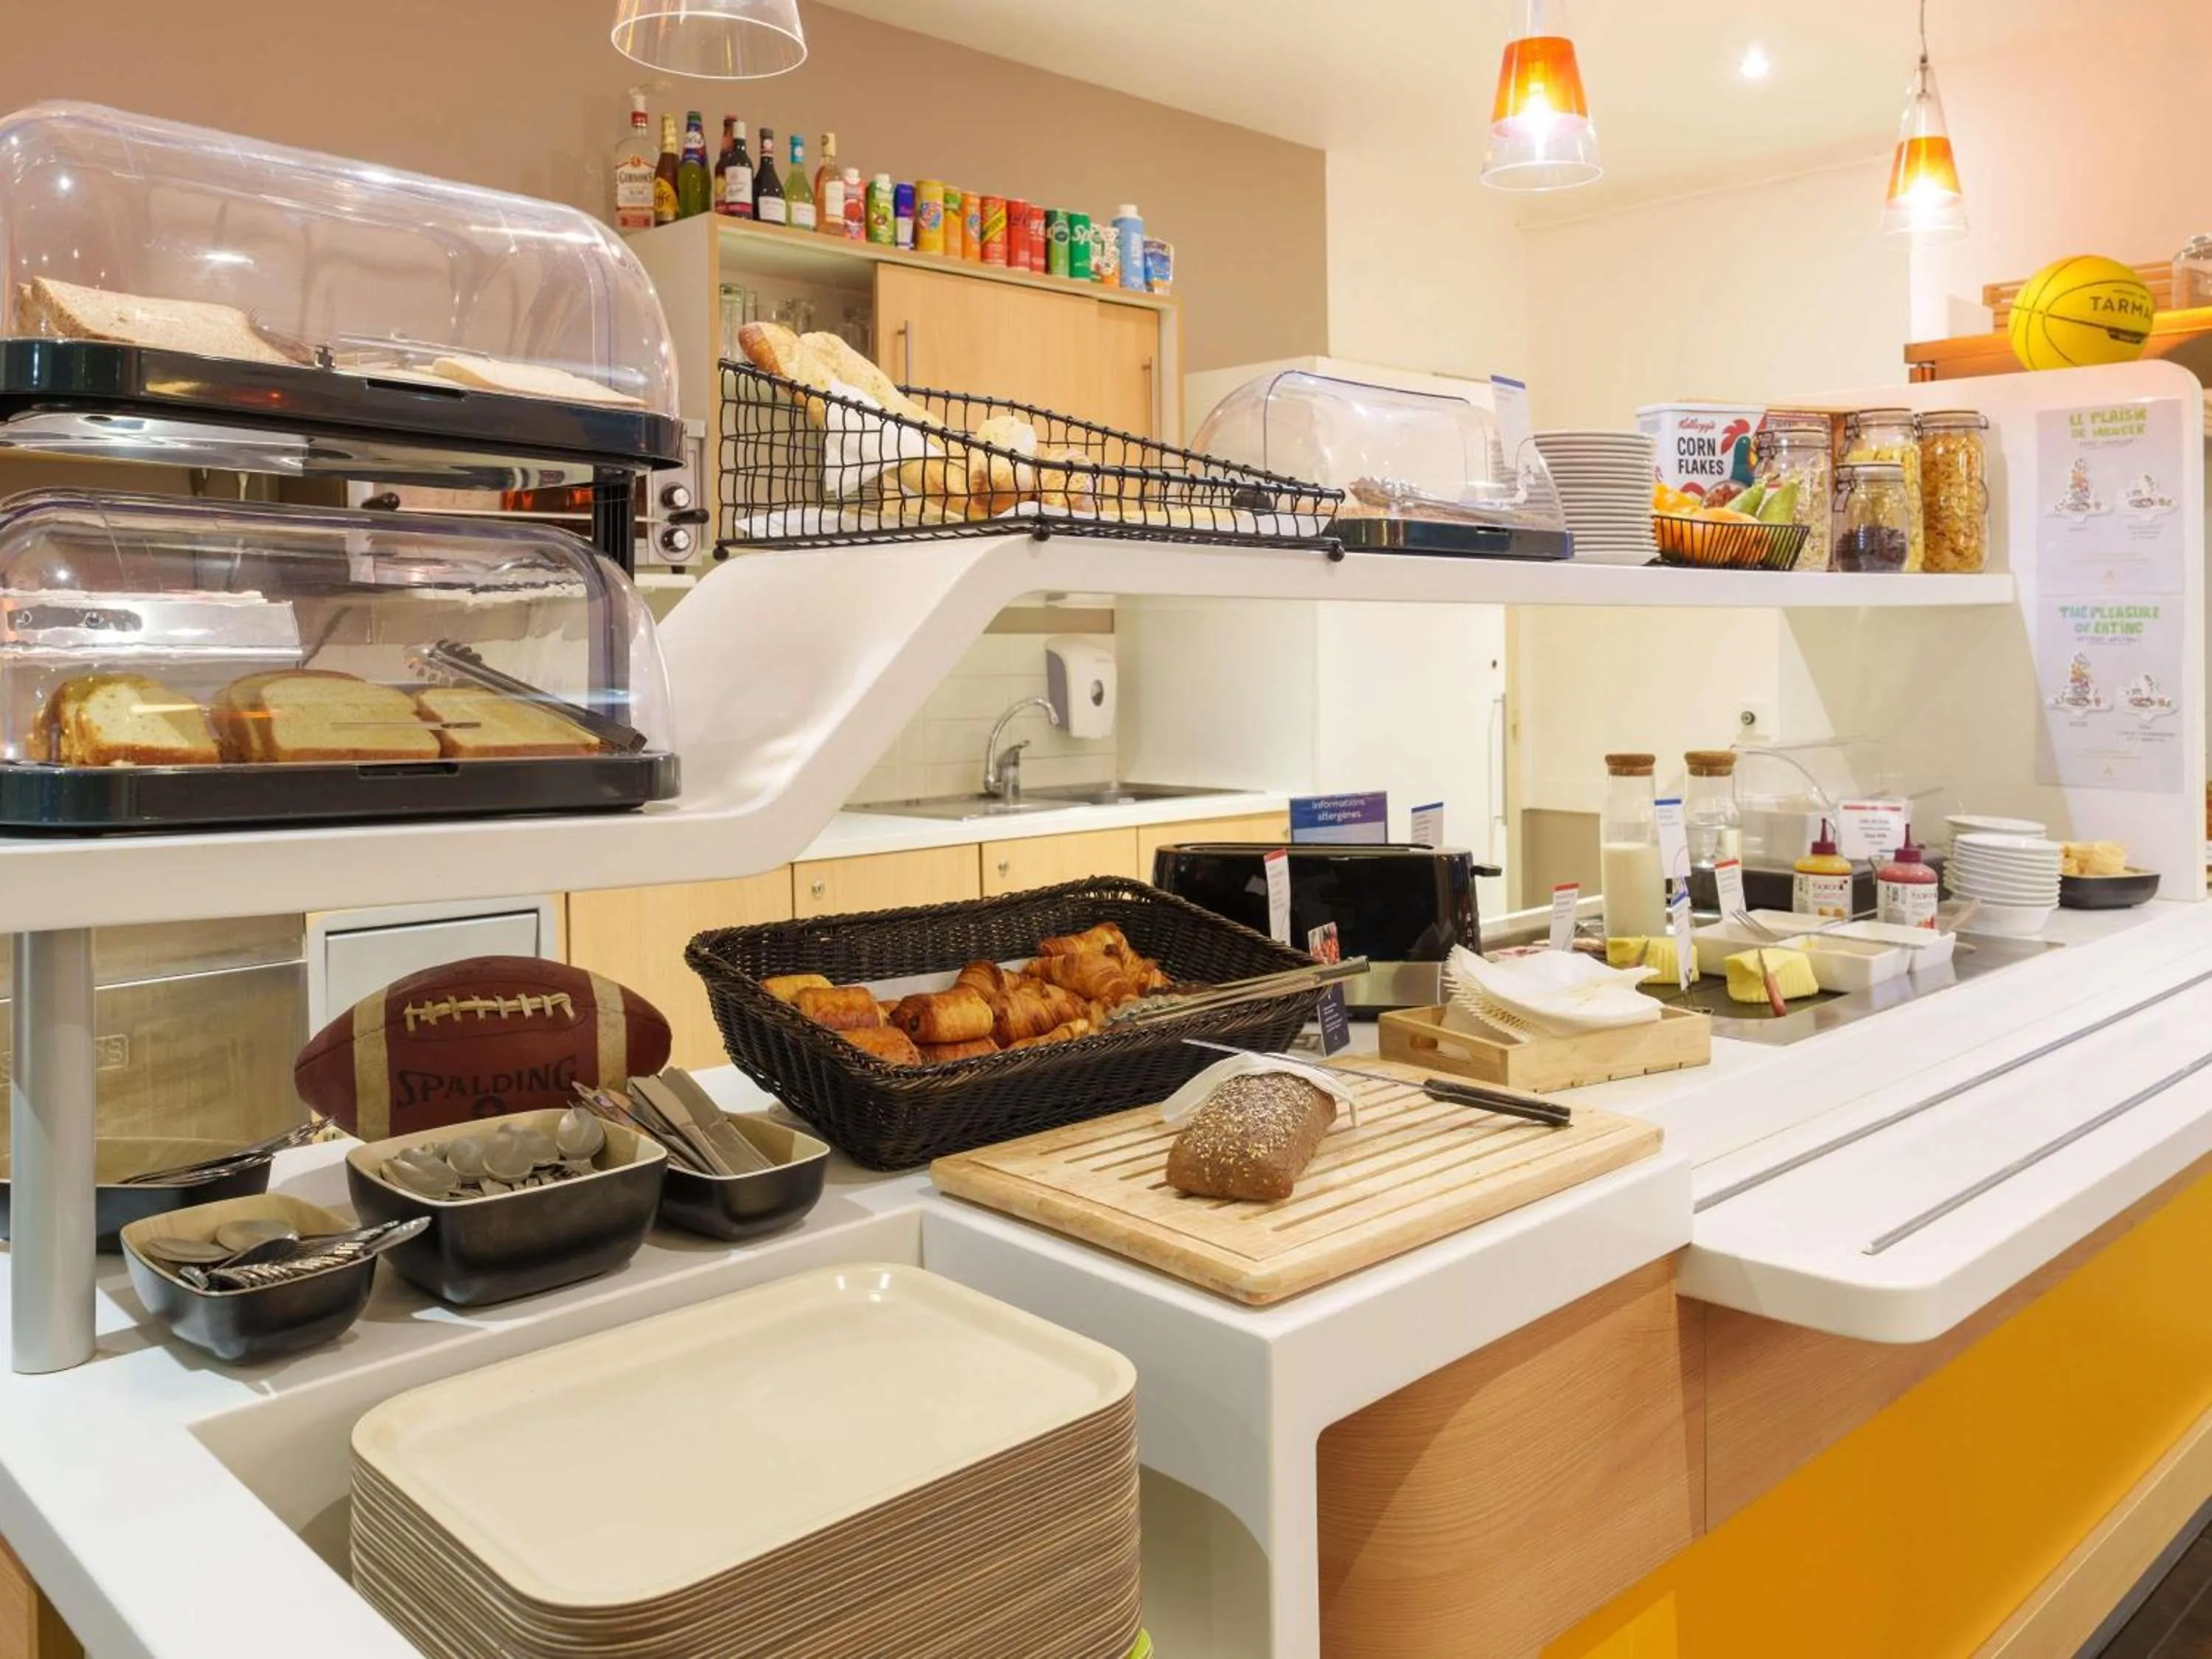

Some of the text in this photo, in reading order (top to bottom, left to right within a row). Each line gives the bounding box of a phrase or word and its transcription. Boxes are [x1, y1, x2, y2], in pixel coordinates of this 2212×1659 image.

[1677, 437, 1716, 456] CORN
[1677, 458, 1725, 476] FLAKES
[1312, 799, 1366, 810] Informations
[397, 1053, 577, 1108] SPALDING
